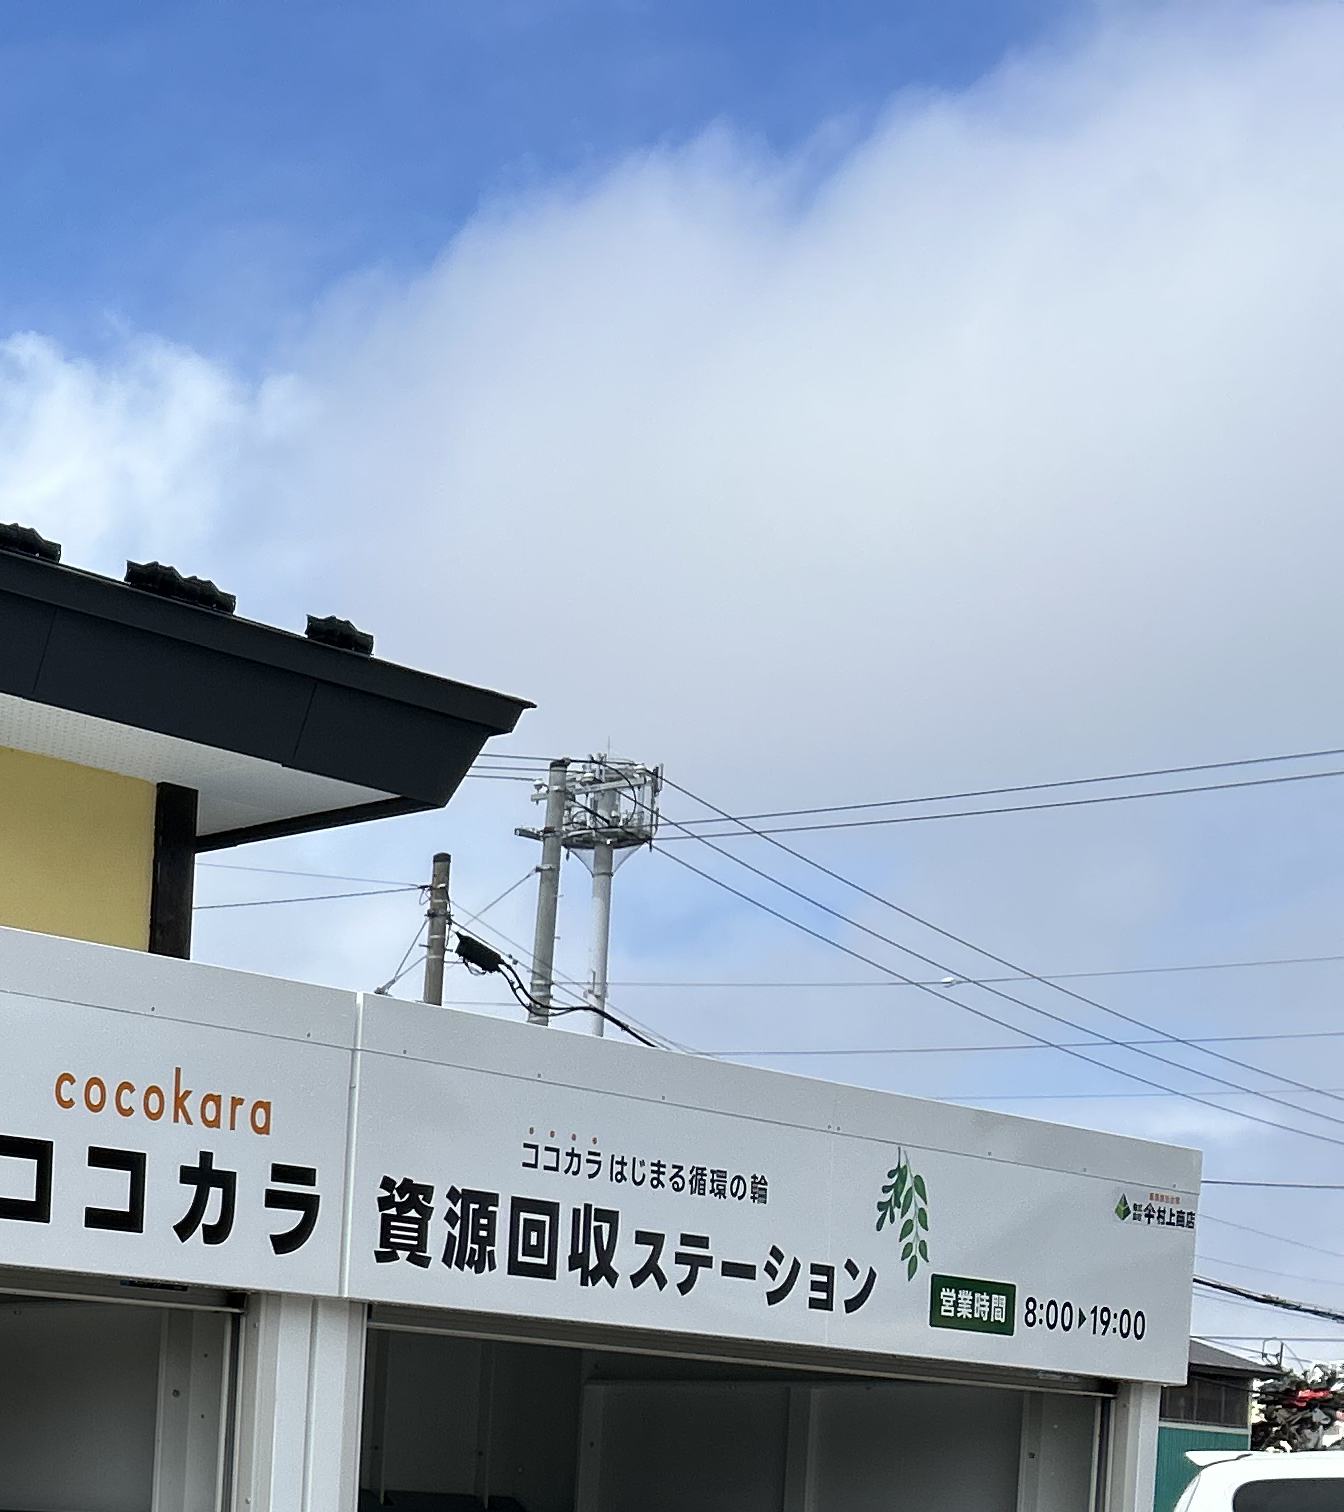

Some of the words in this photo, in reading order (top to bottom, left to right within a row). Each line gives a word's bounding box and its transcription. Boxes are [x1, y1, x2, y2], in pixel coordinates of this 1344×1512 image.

[55, 1066, 272, 1136] cocokara
[374, 1175, 877, 1315] 資源回収ステーション
[940, 1288, 1007, 1323] 営業時間
[1024, 1297, 1074, 1331] 8:00
[1090, 1306, 1146, 1340] 19:00
